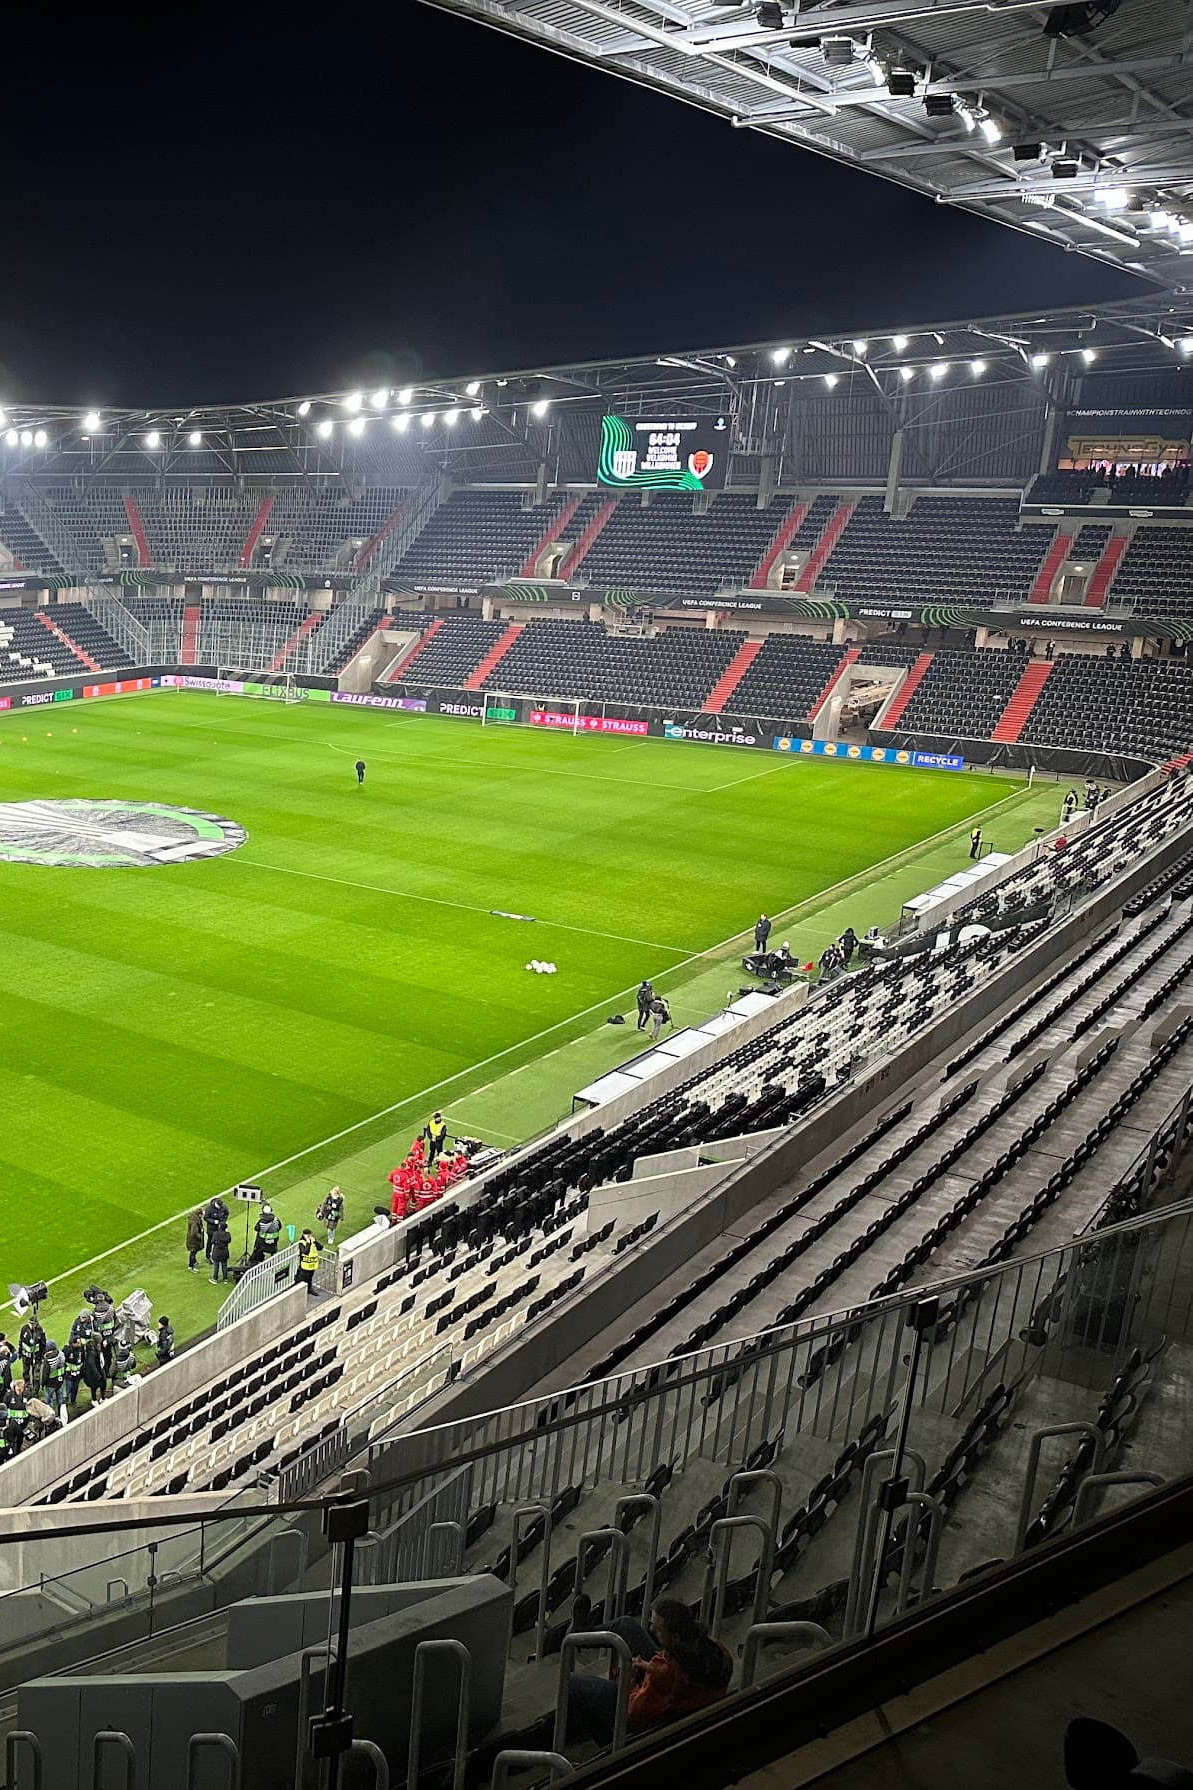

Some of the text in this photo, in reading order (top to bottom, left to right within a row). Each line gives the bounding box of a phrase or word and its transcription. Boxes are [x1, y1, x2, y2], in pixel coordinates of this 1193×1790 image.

[649, 432, 680, 446] 64:04
[699, 600, 737, 608] CONFERENCE
[738, 602, 762, 610] LEAGUE
[858, 609, 891, 617] PREDICT
[1020, 618, 1123, 632] UEFA CONFERENCE LEAGUE
[21, 692, 54, 705] PREDICT
[439, 702, 485, 717] PREDICT
[602, 720, 646, 733] STRAUSS
[670, 725, 757, 745] enterprise
[917, 754, 959, 768] RECYCLE
